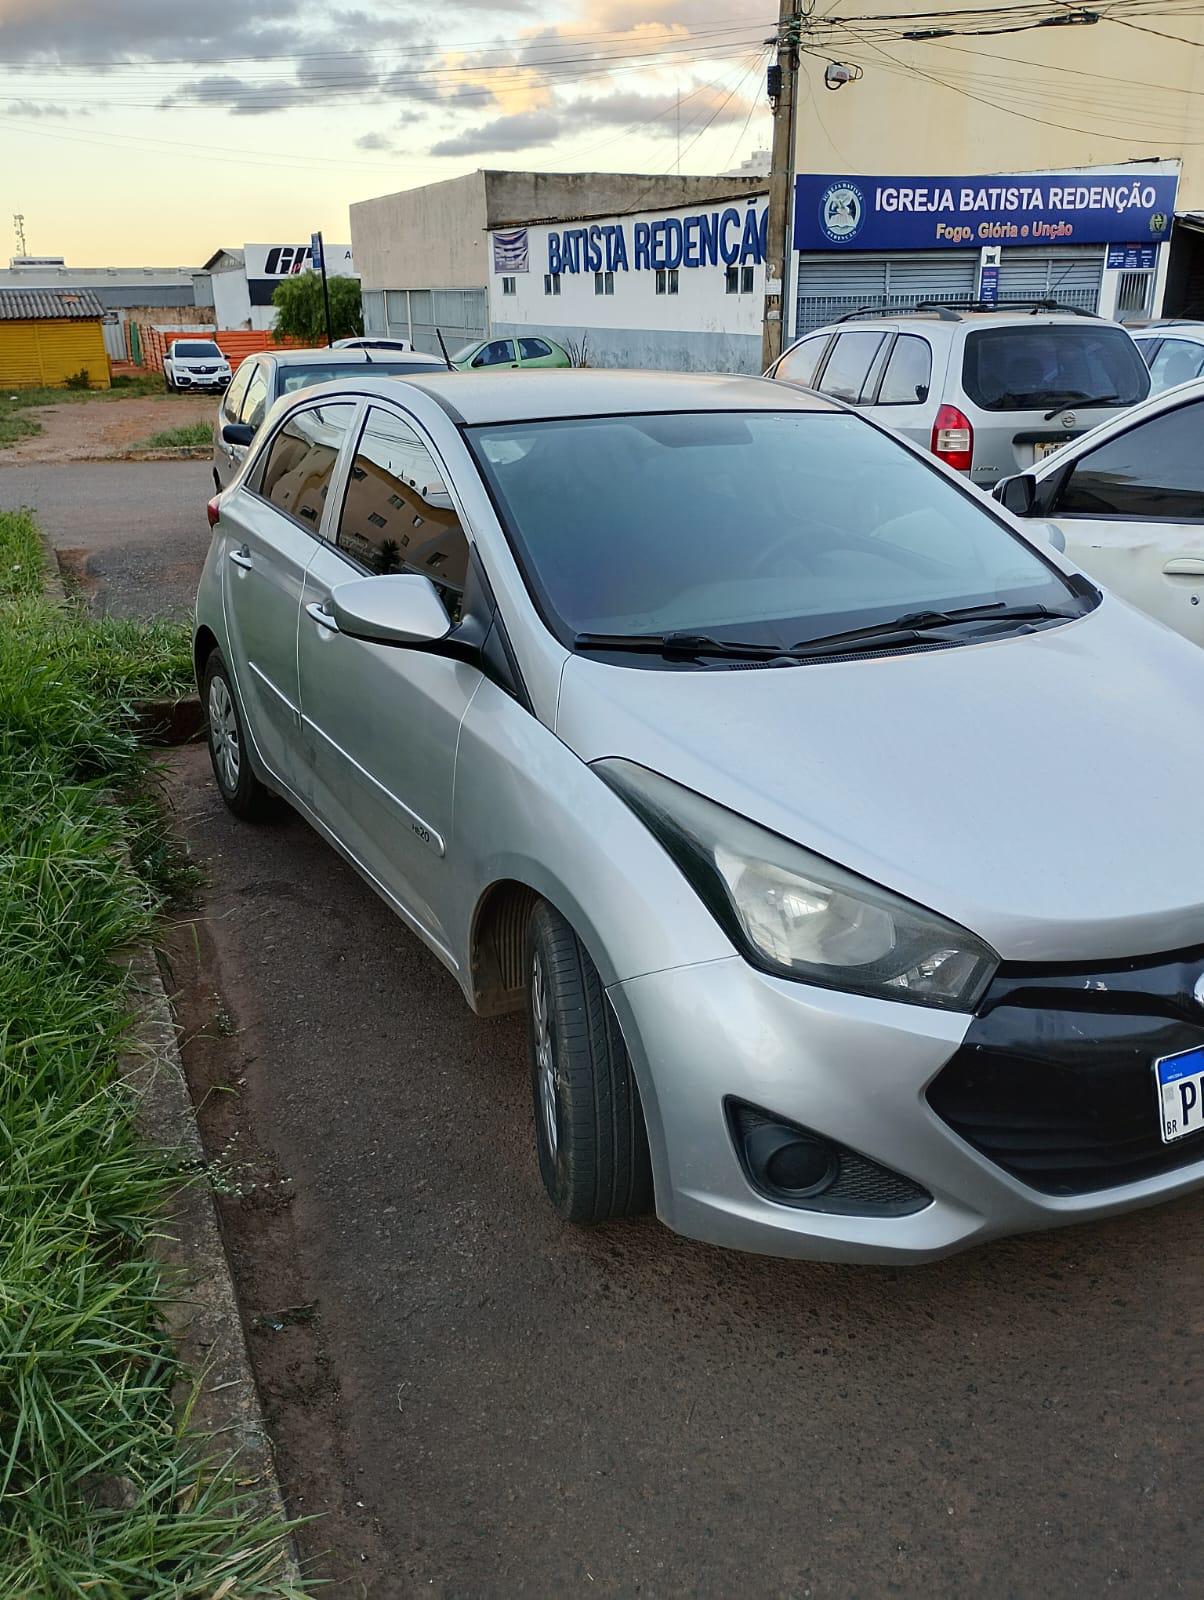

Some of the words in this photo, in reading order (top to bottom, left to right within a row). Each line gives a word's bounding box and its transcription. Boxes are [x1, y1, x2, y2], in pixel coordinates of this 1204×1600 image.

[875, 187, 954, 213] IGREJA
[959, 186, 1043, 212] BATISTA
[1048, 181, 1156, 214] REDENÇÃO
[935, 223, 974, 242] Fogo,
[977, 220, 1018, 239] Glória
[1020, 226, 1029, 237] e
[1032, 219, 1073, 240] Unção
[547, 223, 629, 275] BATISTA
[1166, 1119, 1178, 1135] BR
